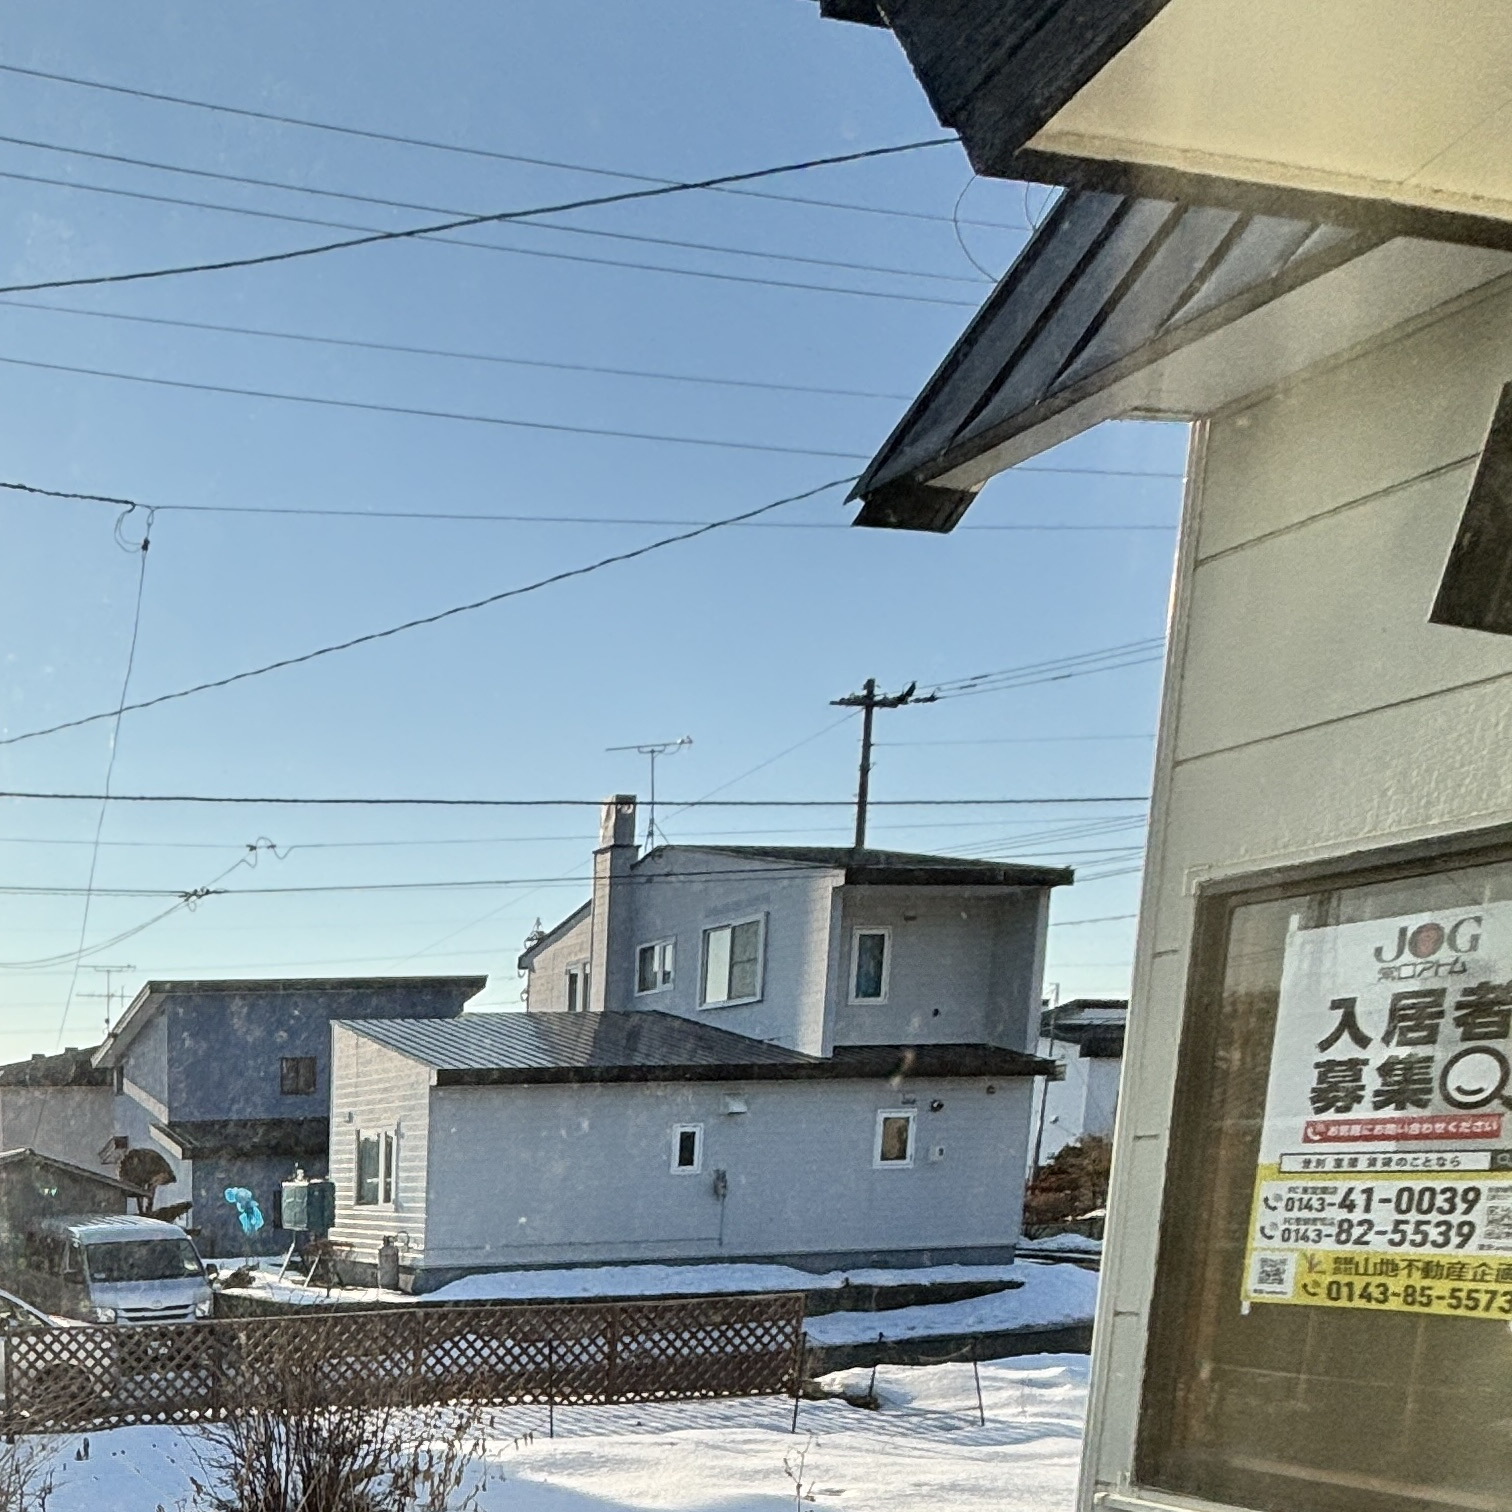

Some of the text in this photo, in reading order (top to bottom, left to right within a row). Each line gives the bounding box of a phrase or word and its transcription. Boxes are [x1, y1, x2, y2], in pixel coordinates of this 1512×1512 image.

[1373, 915, 1483, 963] JOG
[1315, 980, 1512, 1053] 入居者
[1309, 1052, 1435, 1115] 募集
[1284, 1186, 1482, 1216] 0143-41-0039
[1281, 1218, 1476, 1249] 0143-82-5539
